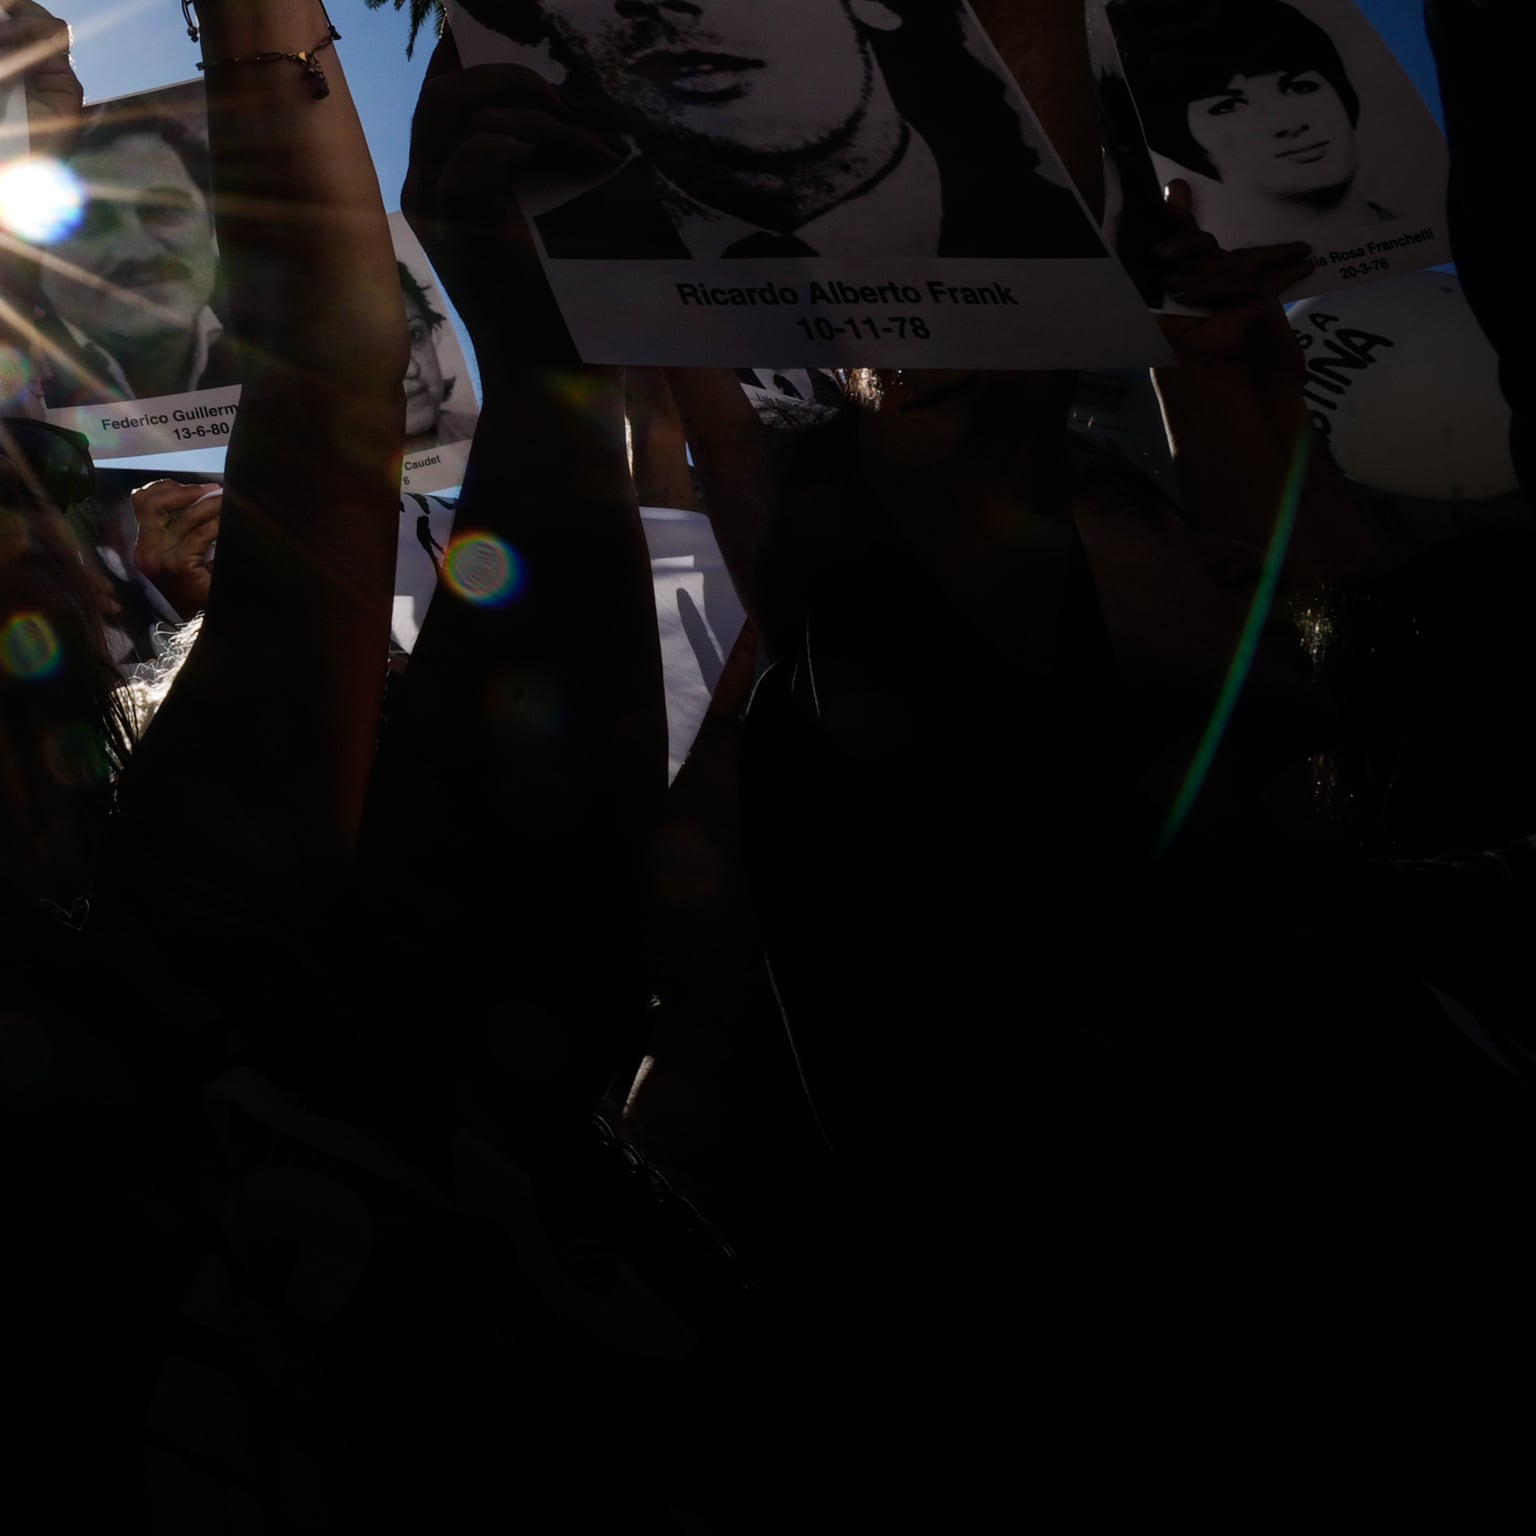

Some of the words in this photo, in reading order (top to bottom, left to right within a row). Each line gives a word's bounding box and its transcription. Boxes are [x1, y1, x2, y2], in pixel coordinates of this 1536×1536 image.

[1329, 247, 1366, 265] Rosa
[1367, 227, 1435, 255] Franchelli
[676, 282, 799, 307] Ricardo
[808, 281, 922, 306] Alberto
[928, 281, 1021, 306] Frank
[796, 317, 931, 342] 10-11-78
[100, 414, 169, 431] Federico
[173, 422, 230, 440] 13-6-80
[404, 454, 442, 471] Caudet
